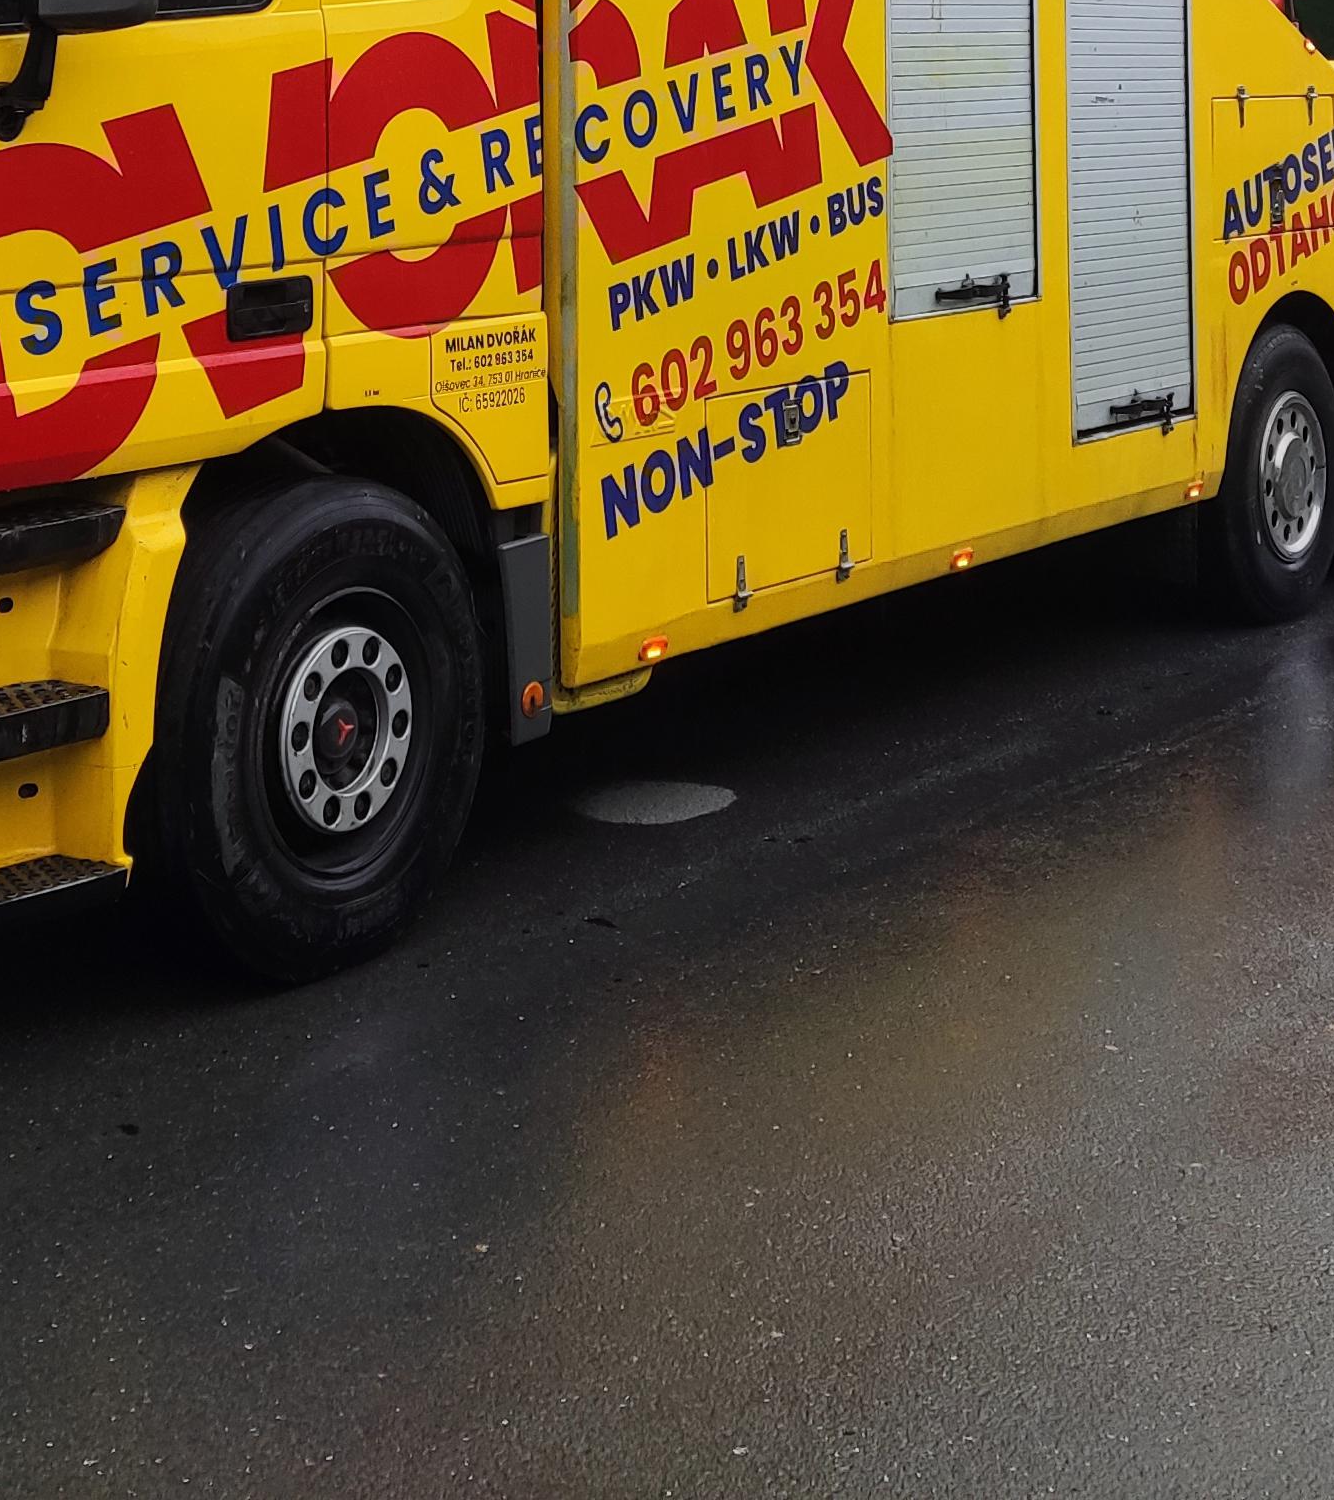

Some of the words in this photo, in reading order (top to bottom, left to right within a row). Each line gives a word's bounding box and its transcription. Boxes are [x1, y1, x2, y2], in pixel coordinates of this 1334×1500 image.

[14, 167, 395, 356] SERVICE
[418, 147, 460, 214] &
[480, 40, 806, 194] RECOVERY
[609, 253, 695, 331] PKW
[727, 210, 800, 282] LKW
[828, 176, 884, 237] BUS
[445, 334, 484, 353] MILAN
[486, 324, 536, 349] DVOŘÁK
[450, 357, 472, 372] Tel.:
[474, 353, 493, 369] 602
[475, 386, 526, 411] 65922026
[631, 336, 717, 427] 602
[727, 296, 805, 380] 963
[814, 259, 886, 341] 354
[601, 360, 849, 539] NON-STOP
